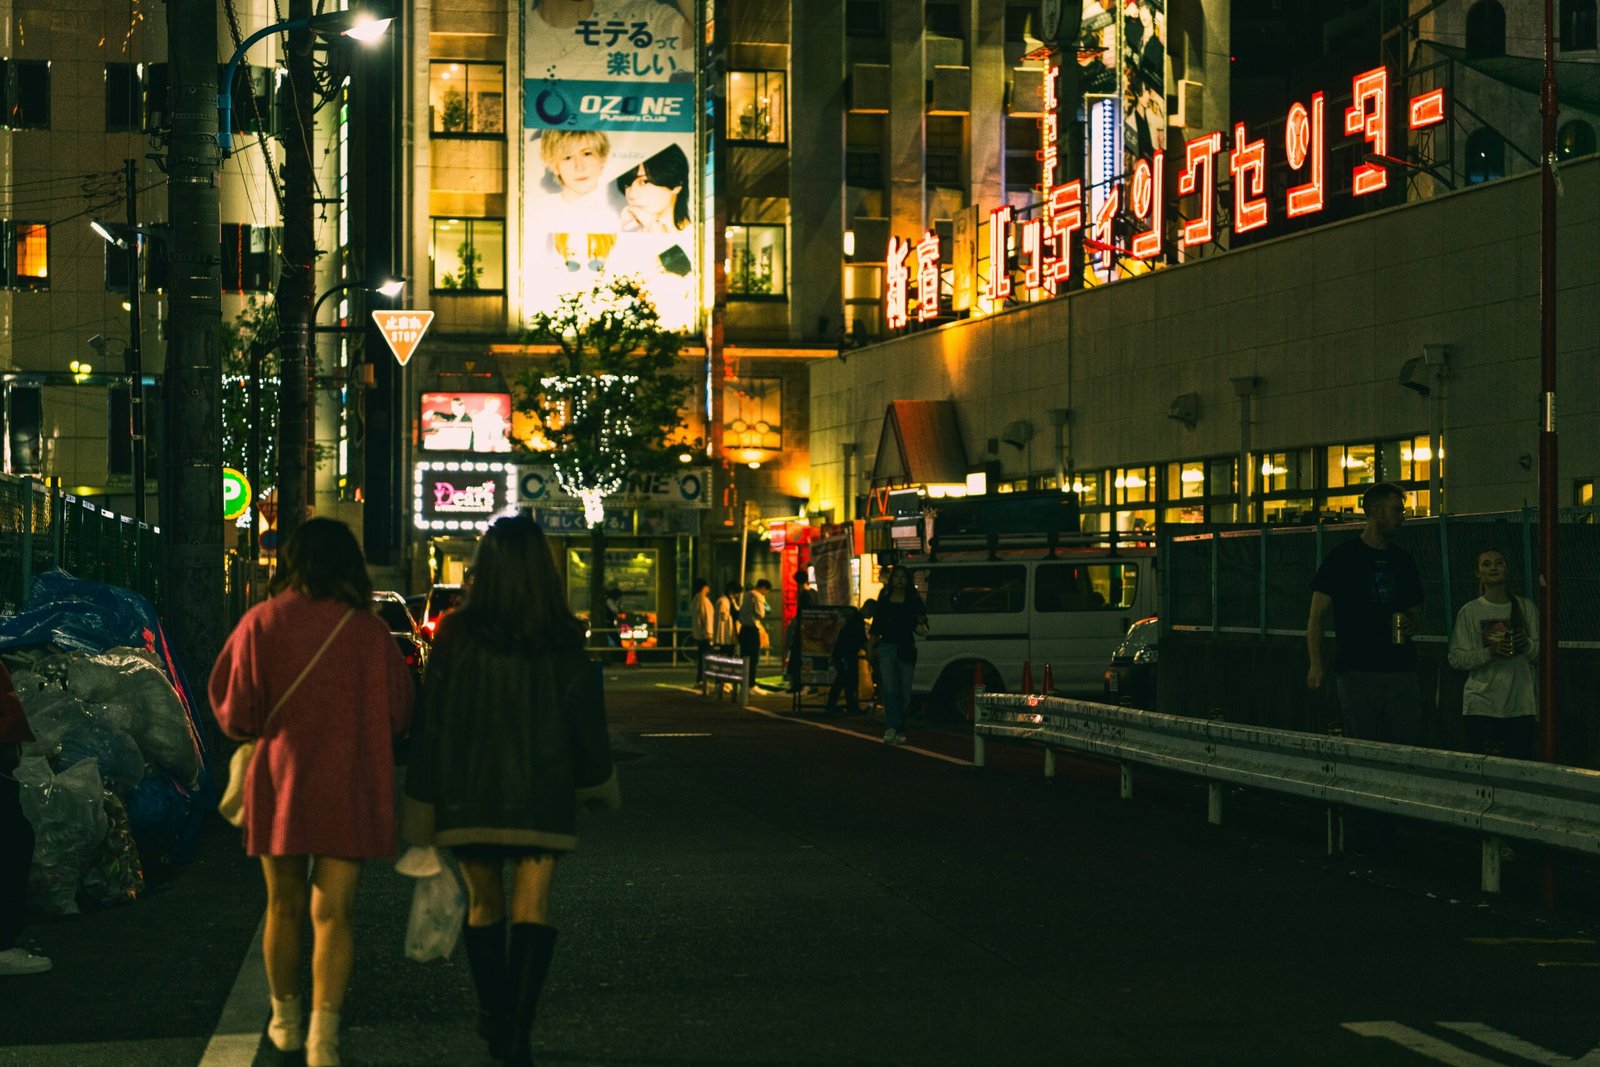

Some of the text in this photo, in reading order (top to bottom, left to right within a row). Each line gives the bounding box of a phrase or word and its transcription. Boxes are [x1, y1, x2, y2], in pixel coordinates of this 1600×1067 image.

[575, 20, 679, 49] モテるって
[579, 95, 684, 115] OZONE
[391, 331, 417, 343] STOP
[223, 478, 241, 512] P
